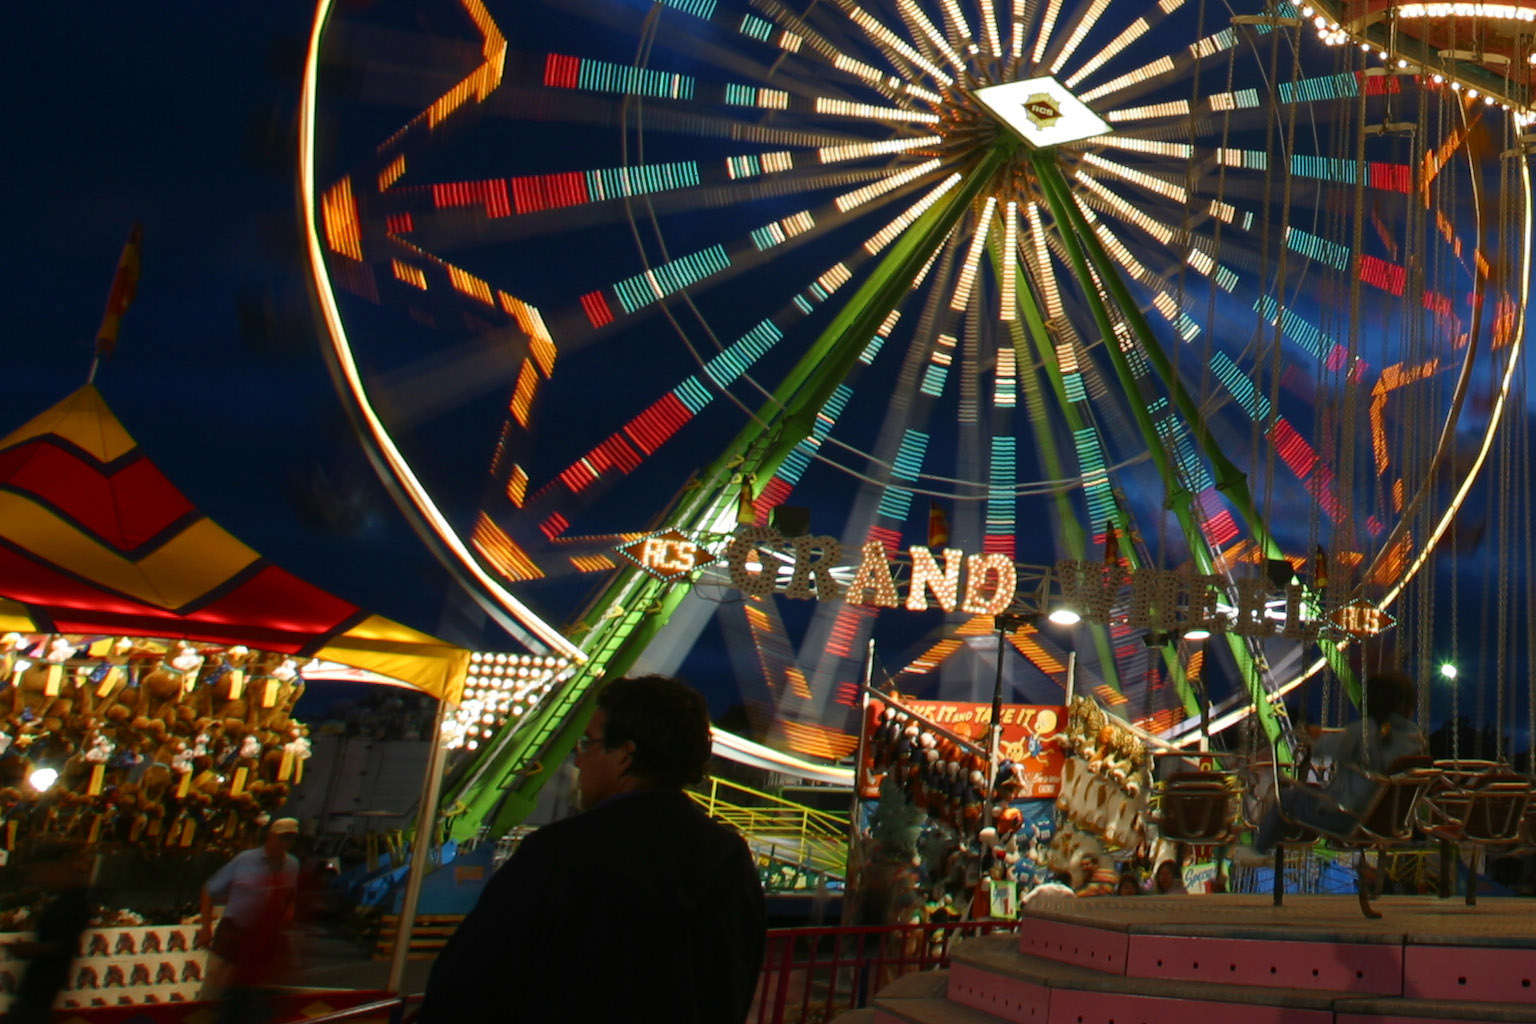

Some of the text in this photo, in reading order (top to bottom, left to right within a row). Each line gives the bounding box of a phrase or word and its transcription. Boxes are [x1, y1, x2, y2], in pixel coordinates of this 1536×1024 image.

[643, 538, 697, 570] RCS
[727, 525, 1324, 640] GRAND WHEEL
[936, 705, 958, 723] IT
[952, 711, 973, 723] AND
[1016, 709, 1037, 726] IT
